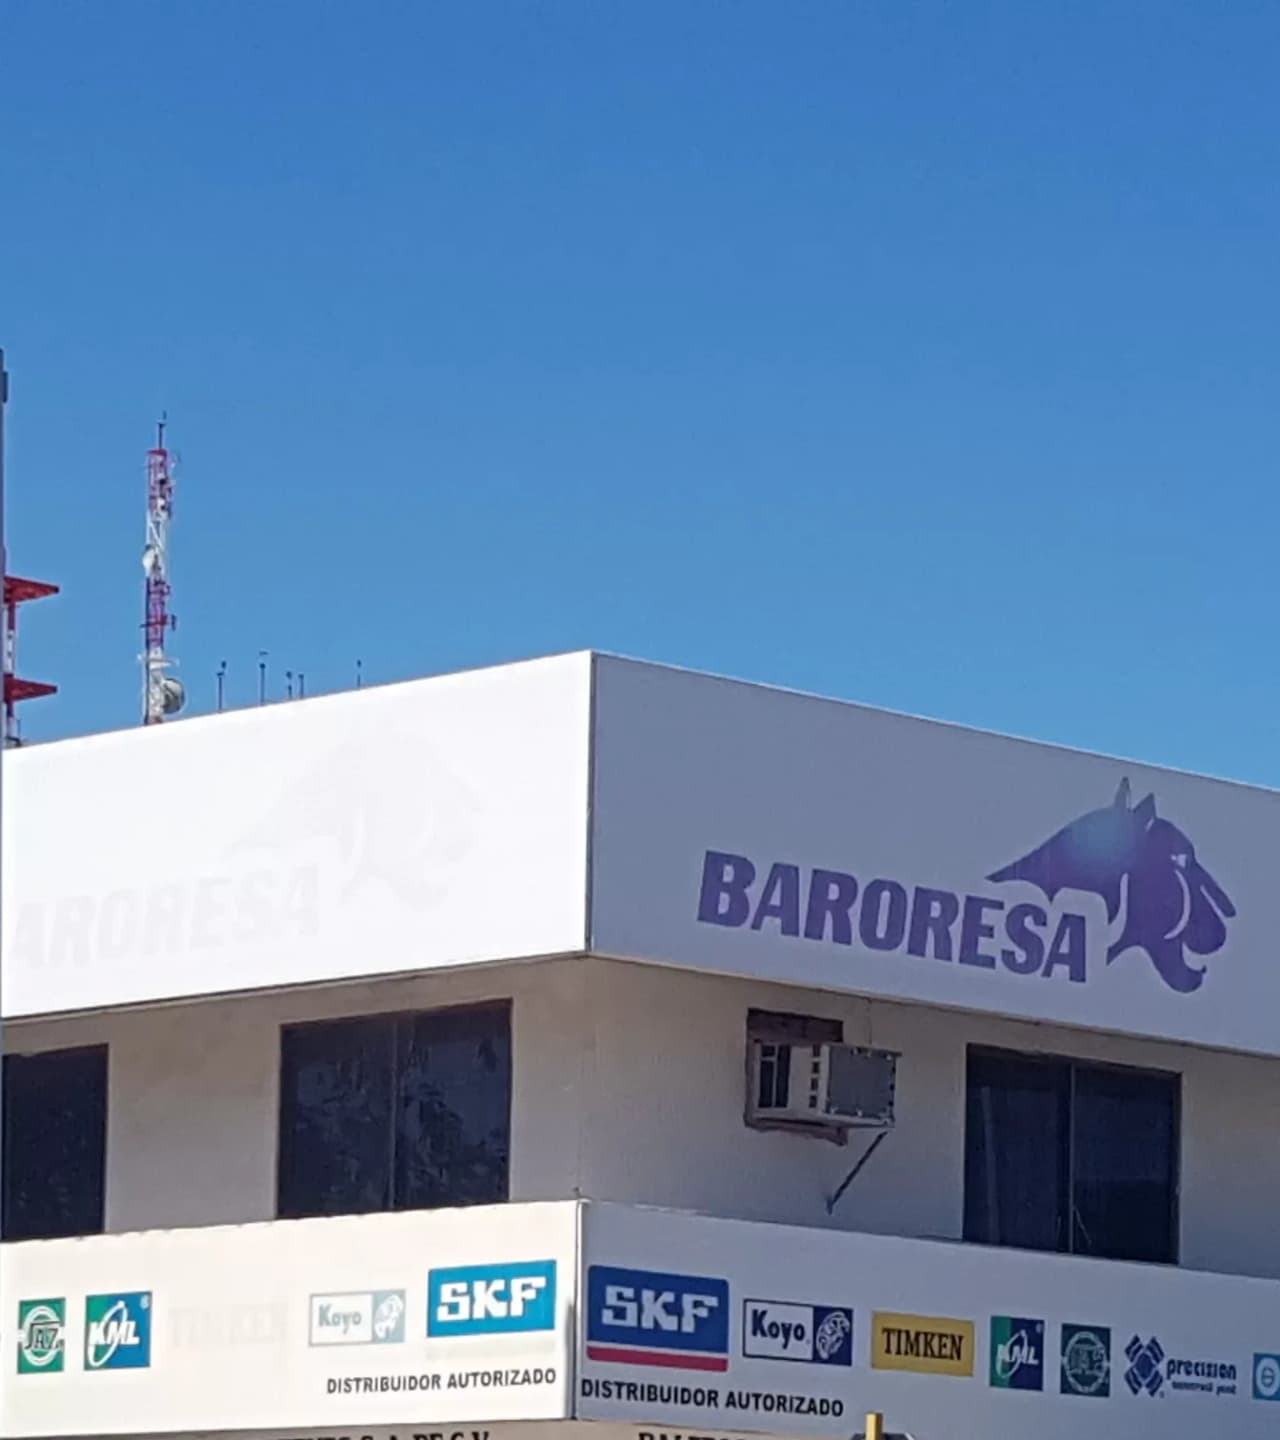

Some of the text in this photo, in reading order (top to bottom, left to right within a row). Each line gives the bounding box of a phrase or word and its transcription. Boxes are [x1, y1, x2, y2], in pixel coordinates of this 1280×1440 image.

[697, 850, 1088, 984] BARORESA
[436, 1275, 548, 1321] SKF
[601, 1284, 719, 1334] SKF
[318, 1303, 363, 1334] Koyo
[750, 1309, 807, 1349] Koyo
[881, 1327, 964, 1361] TIMKEN
[326, 1367, 557, 1394] DISTRIBUIDOR AUTORIZADO
[1166, 1358, 1237, 1381] precision
[580, 1378, 844, 1417] DISTRIBUIDOR AUTORIZADO
